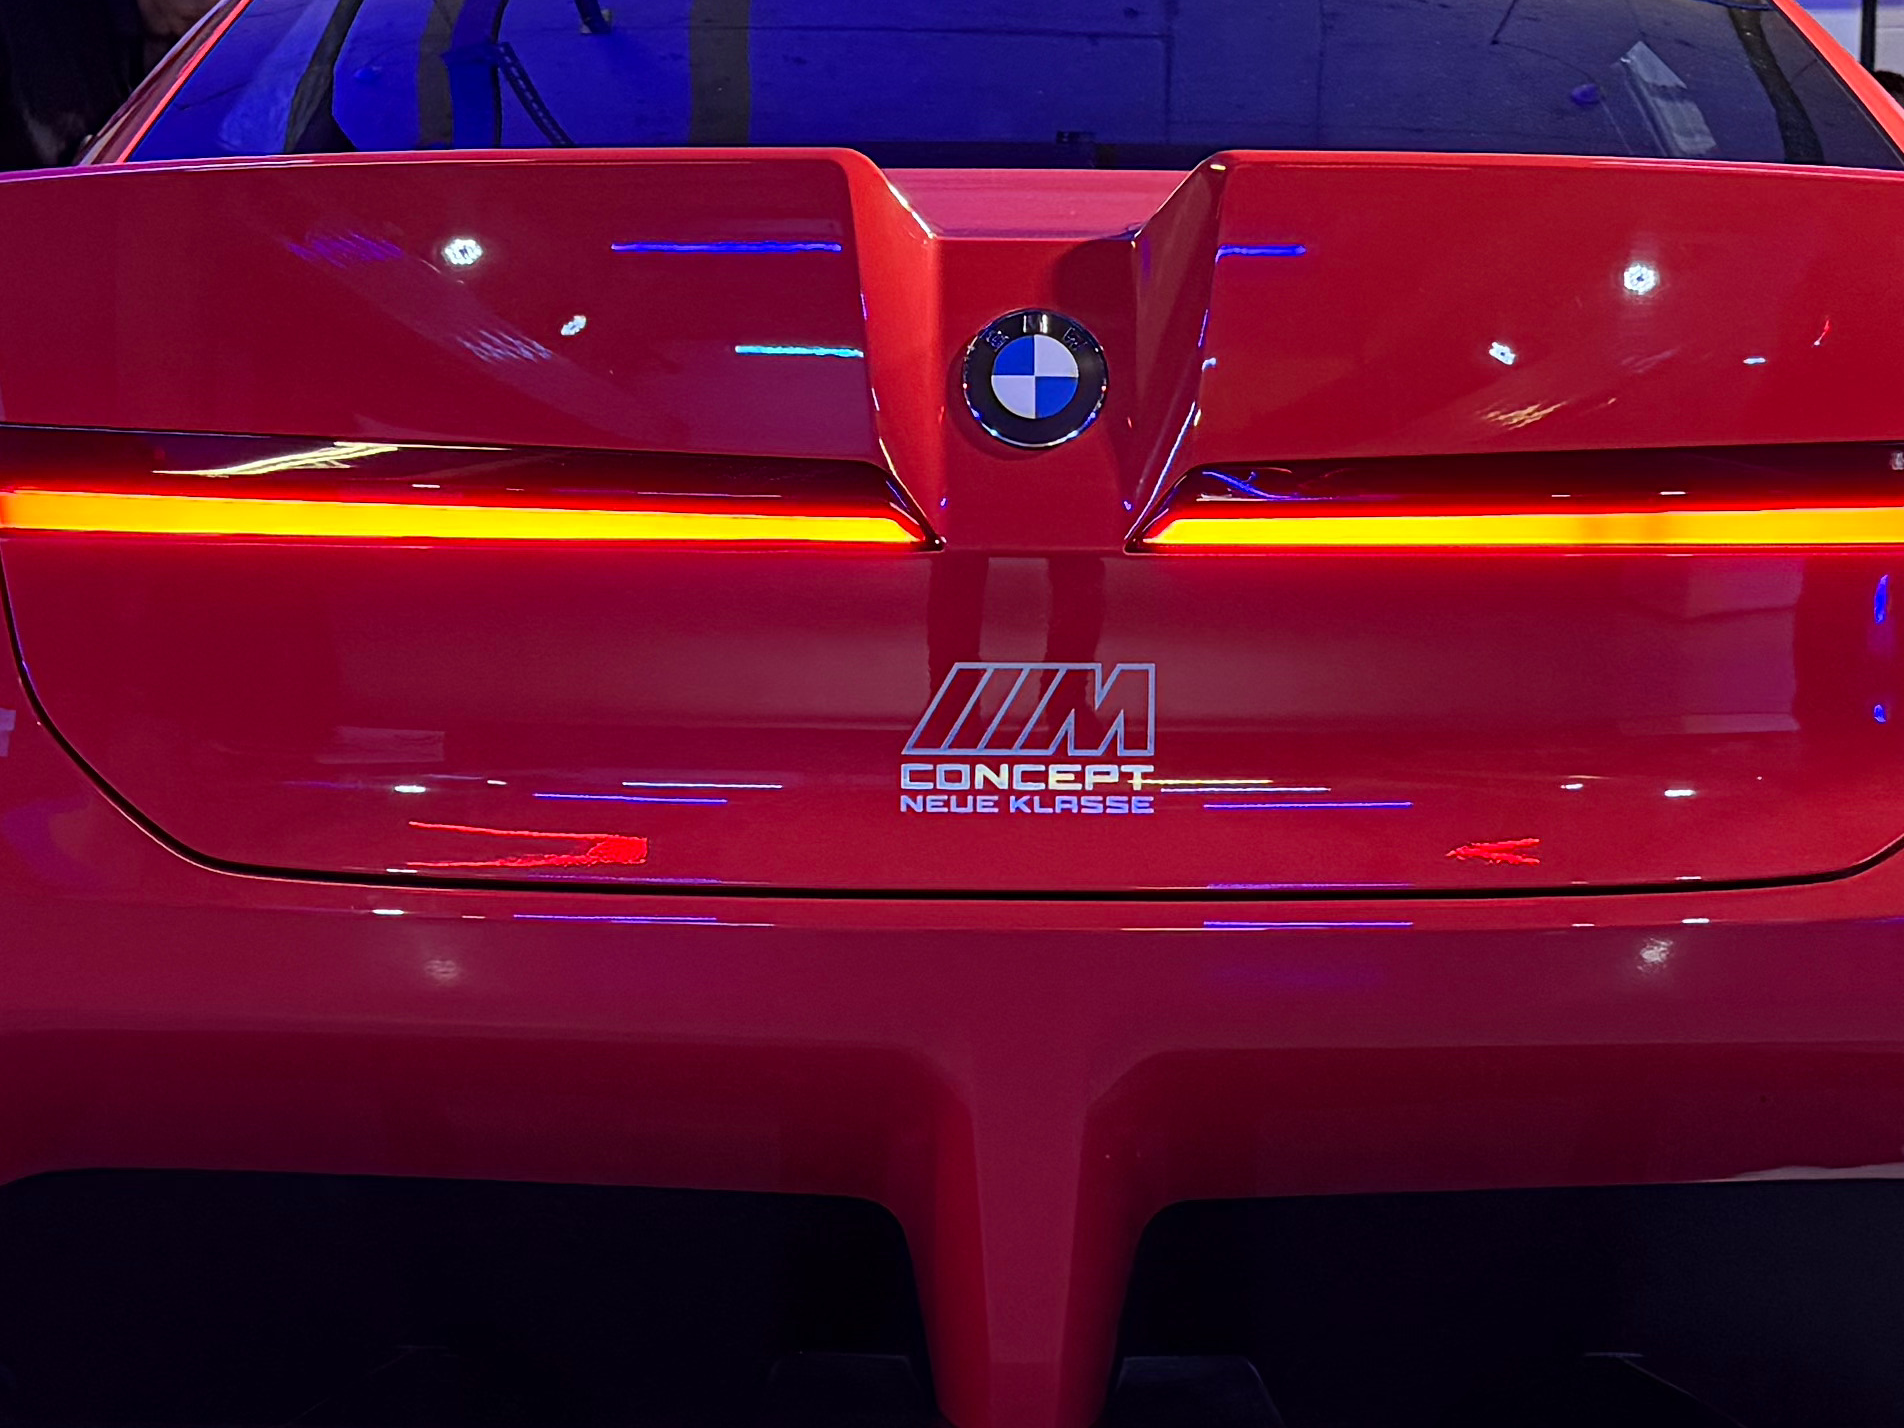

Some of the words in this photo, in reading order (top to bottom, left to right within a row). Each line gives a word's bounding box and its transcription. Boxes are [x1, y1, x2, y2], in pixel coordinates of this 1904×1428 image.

[900, 763, 1155, 791] CONCEPT
[900, 795, 999, 813] NEUE
[1009, 795, 1155, 814] KLASSE
